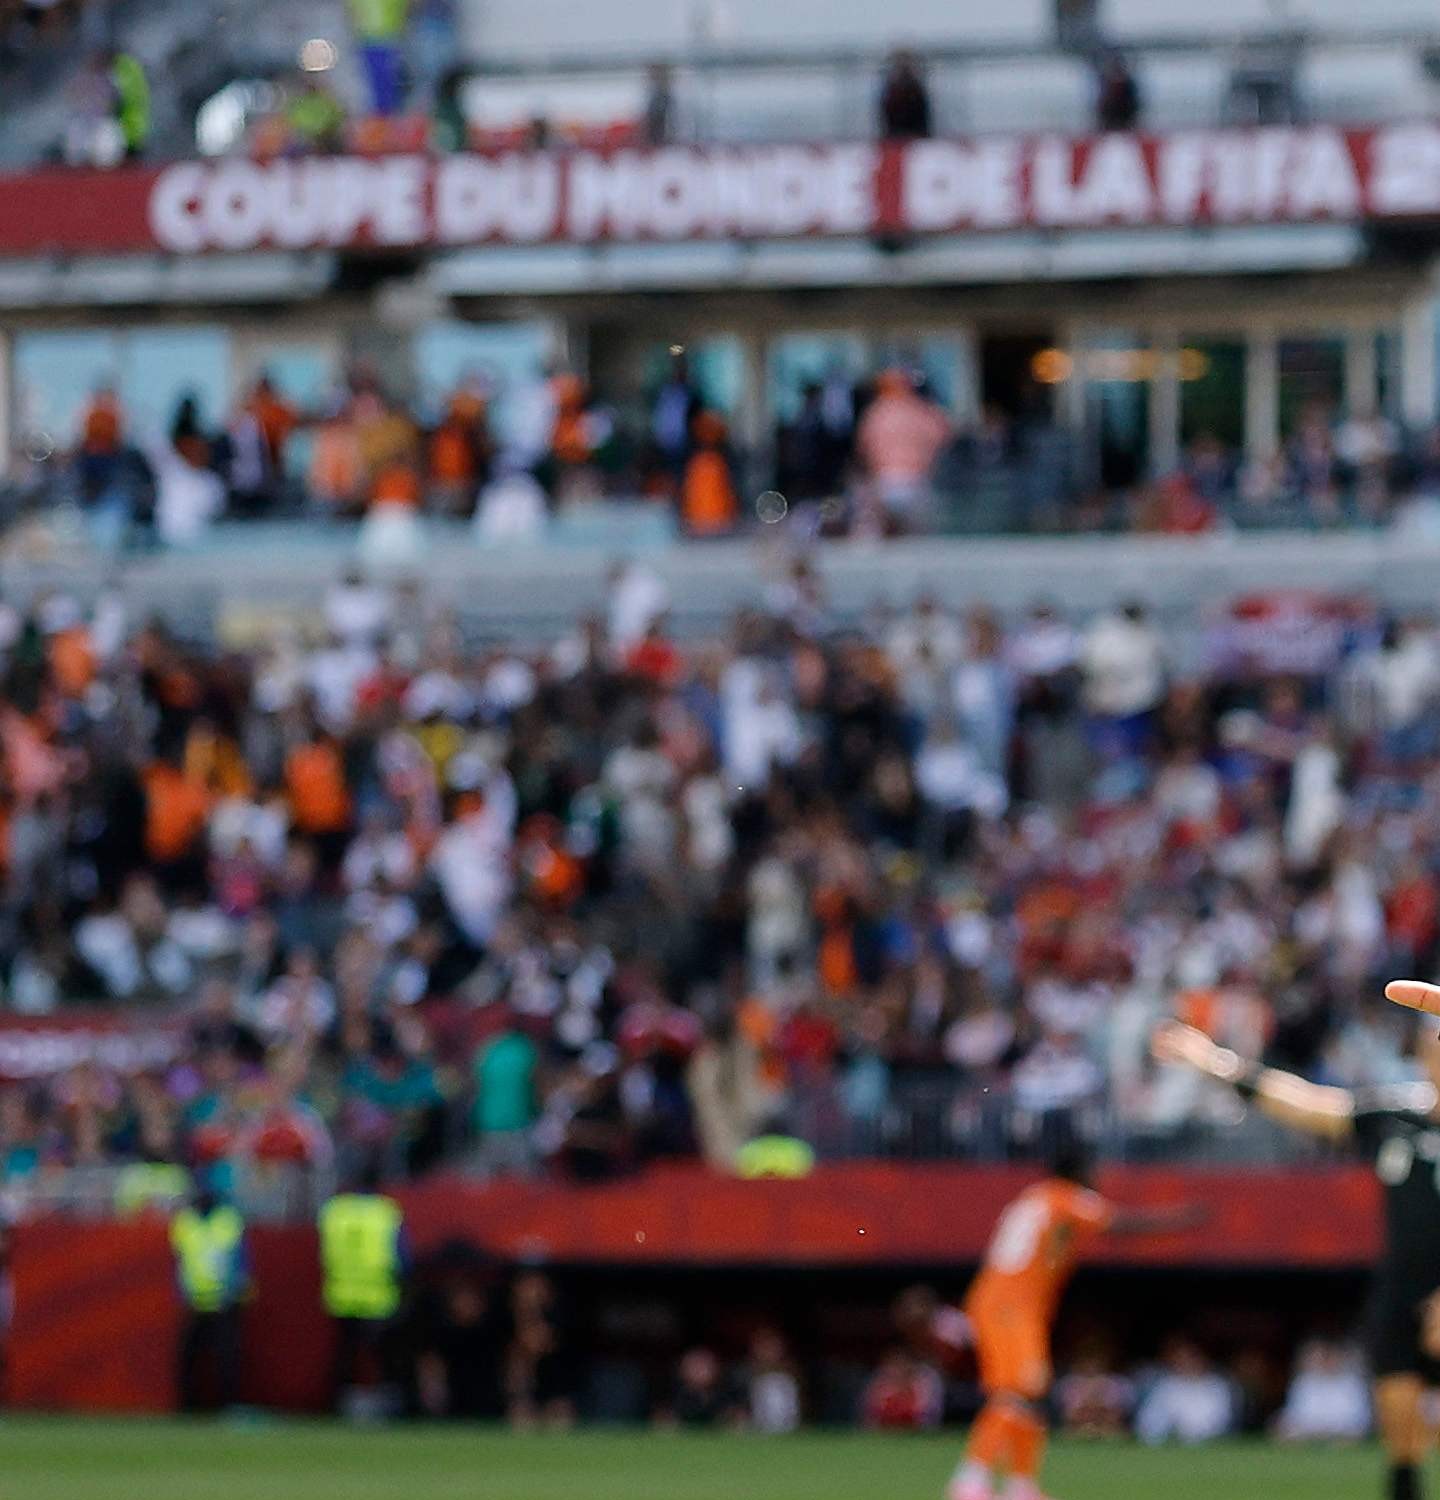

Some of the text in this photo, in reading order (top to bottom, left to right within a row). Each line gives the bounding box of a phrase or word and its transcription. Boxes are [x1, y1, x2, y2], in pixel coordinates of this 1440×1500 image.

[148, 154, 428, 252] COUPE
[436, 149, 559, 244] DU
[568, 139, 872, 241] MONDE
[904, 136, 1020, 229] DE
[1032, 130, 1156, 225] LA
[1159, 124, 1361, 222] FIFA
